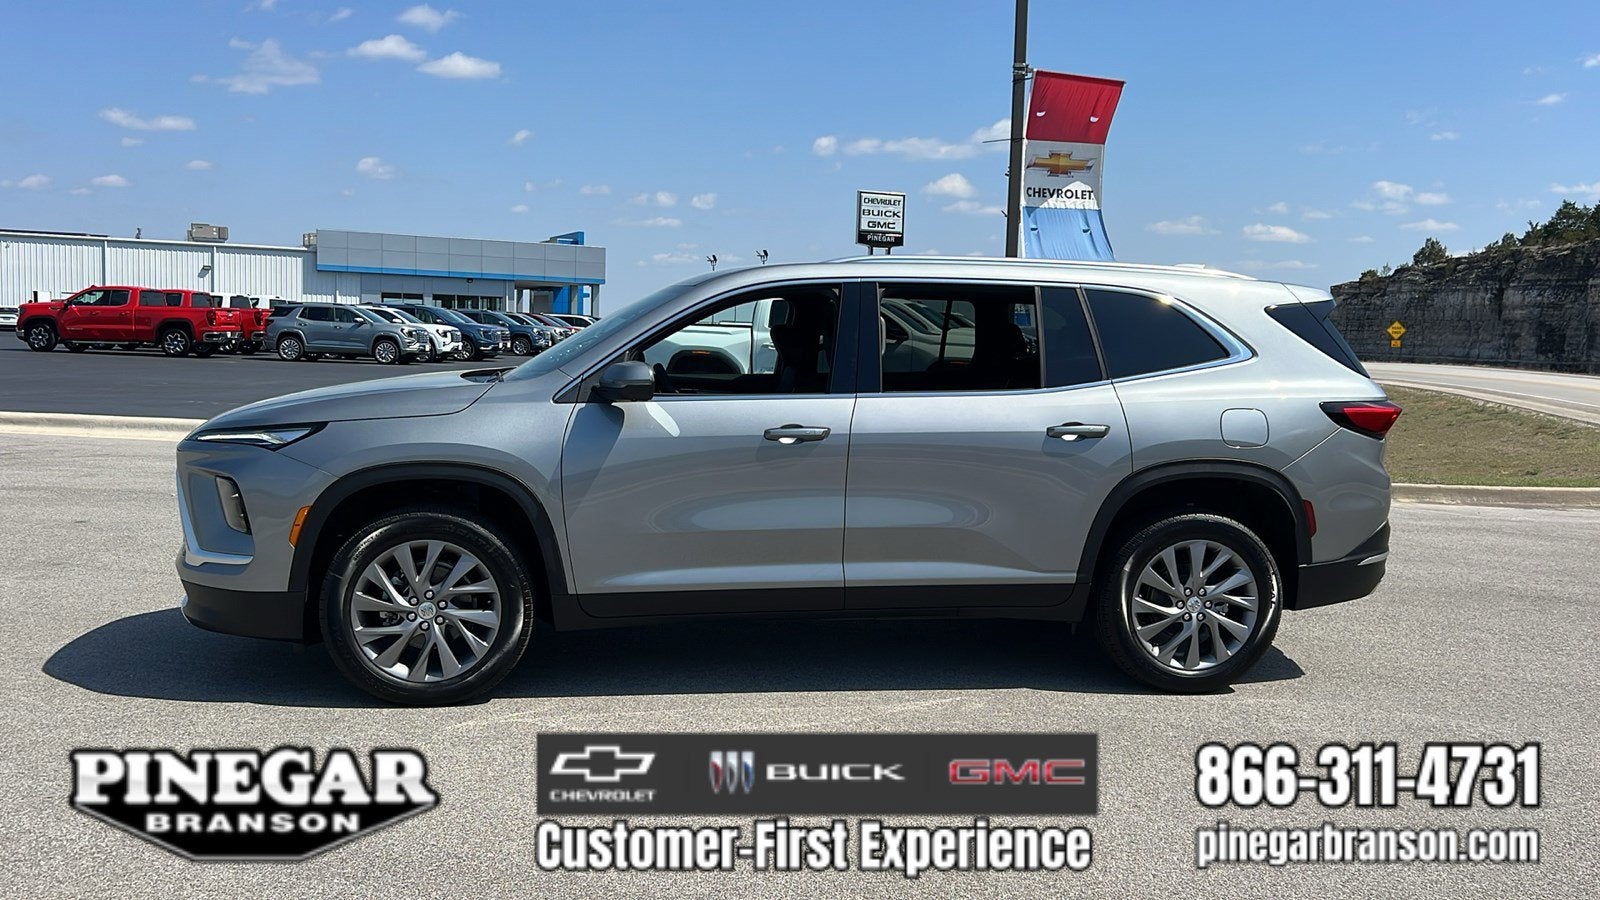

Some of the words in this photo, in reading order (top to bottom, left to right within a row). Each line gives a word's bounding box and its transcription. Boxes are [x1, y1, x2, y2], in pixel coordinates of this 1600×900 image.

[1026, 186, 1094, 201] CHEVROLET
[863, 197, 901, 206] CHEVROLET
[862, 208, 901, 218] BUICK
[867, 220, 896, 230] GMC
[867, 234, 895, 242] PINEGAR
